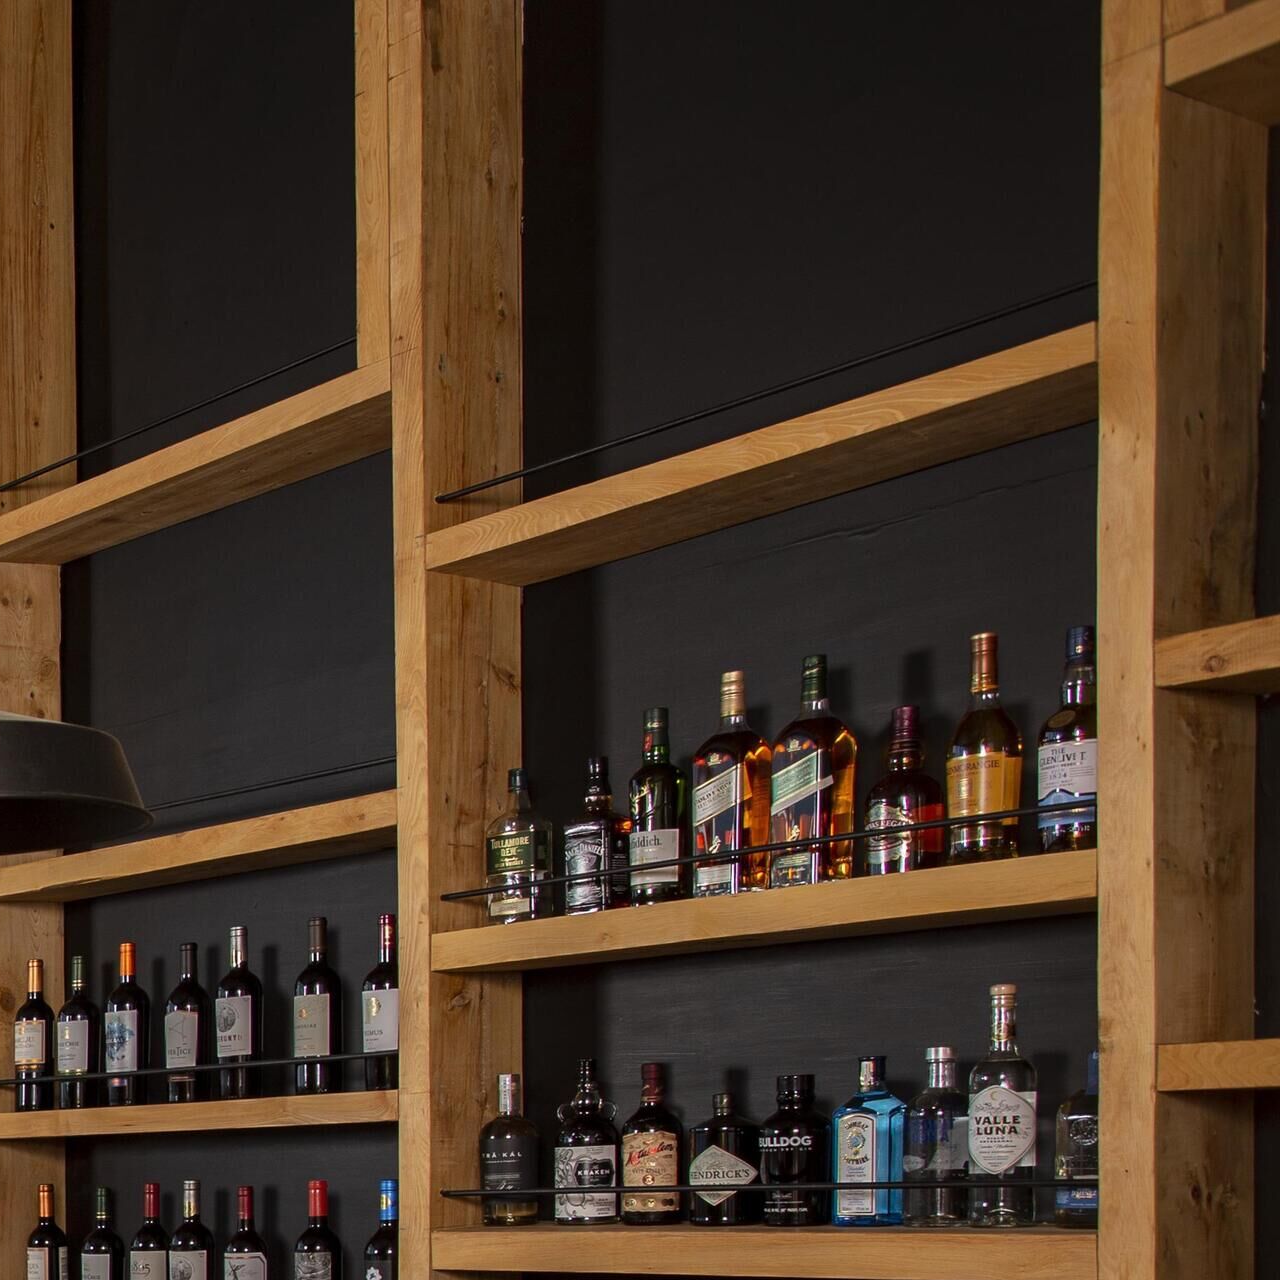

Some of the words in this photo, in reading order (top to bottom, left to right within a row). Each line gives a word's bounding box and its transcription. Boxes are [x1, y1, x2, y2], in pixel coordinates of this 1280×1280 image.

[490, 836, 530, 850] TULLAMORE
[565, 848, 580, 861] JACK
[974, 1115, 1021, 1125] VALLE
[976, 1126, 1018, 1135] LUNA
[759, 1135, 814, 1148] BULLDOG
